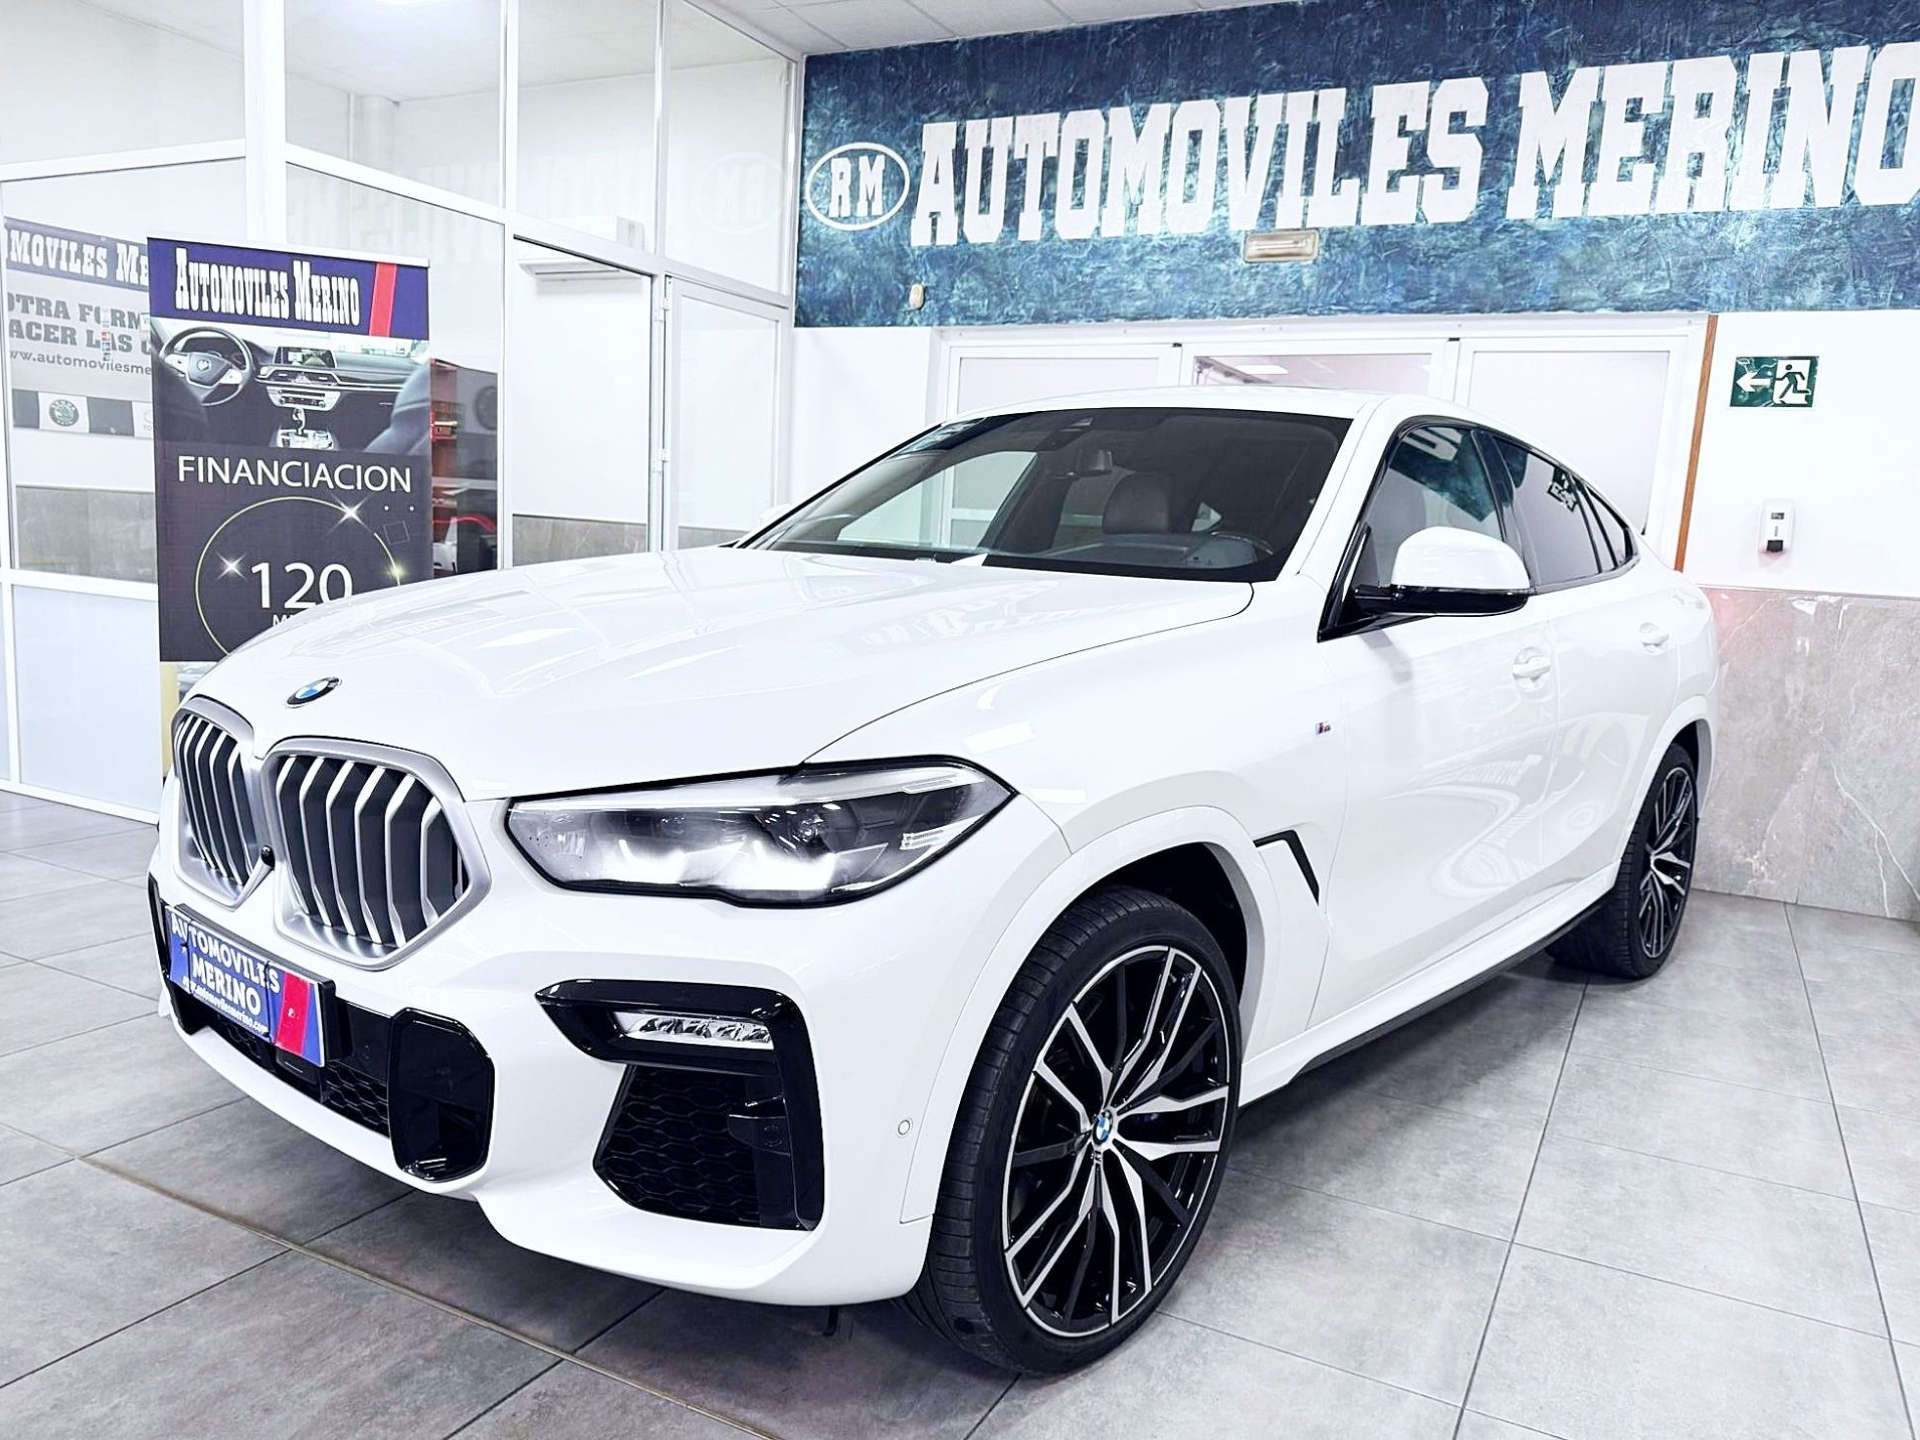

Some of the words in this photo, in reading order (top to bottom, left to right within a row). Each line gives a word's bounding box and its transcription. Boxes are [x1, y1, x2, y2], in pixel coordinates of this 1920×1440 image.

[911, 77, 1489, 246] AUTOMOVILES
[1505, 42, 1920, 219] MERINO
[5, 229, 108, 279] MOVILES
[175, 247, 289, 319] AUTOMOVILES
[293, 260, 360, 326] MERINO
[178, 455, 411, 493] FINANCIACION
[251, 562, 353, 609] 120
[171, 911, 280, 994] AUTOMOVILES
[193, 953, 261, 1016] MERINO
